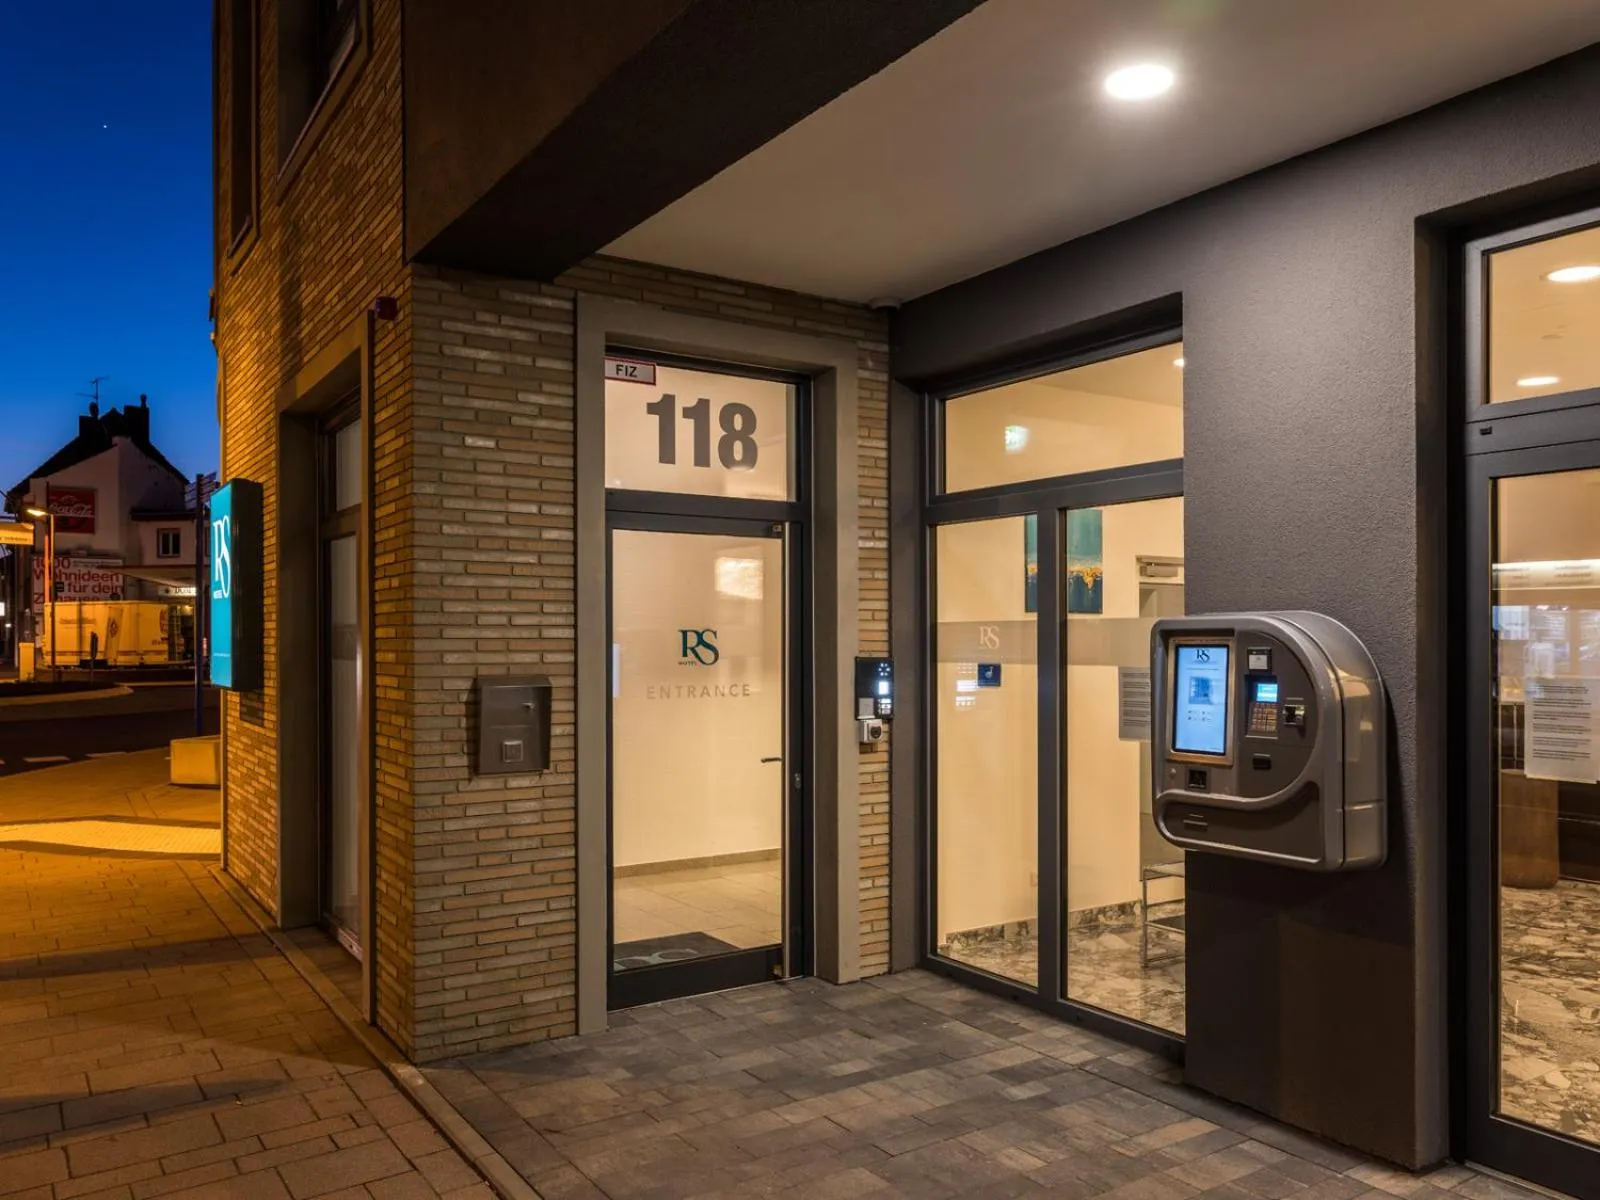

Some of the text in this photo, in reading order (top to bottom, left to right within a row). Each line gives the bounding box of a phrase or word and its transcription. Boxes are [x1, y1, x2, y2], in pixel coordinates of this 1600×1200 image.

[615, 364, 638, 378] FIZ
[646, 393, 758, 471] 118
[34, 557, 70, 569] 100
[213, 515, 231, 598] RS
[67, 582, 90, 593] für
[979, 625, 1000, 649] RS
[678, 629, 720, 666] RS
[646, 683, 751, 700] ENTRANCE
